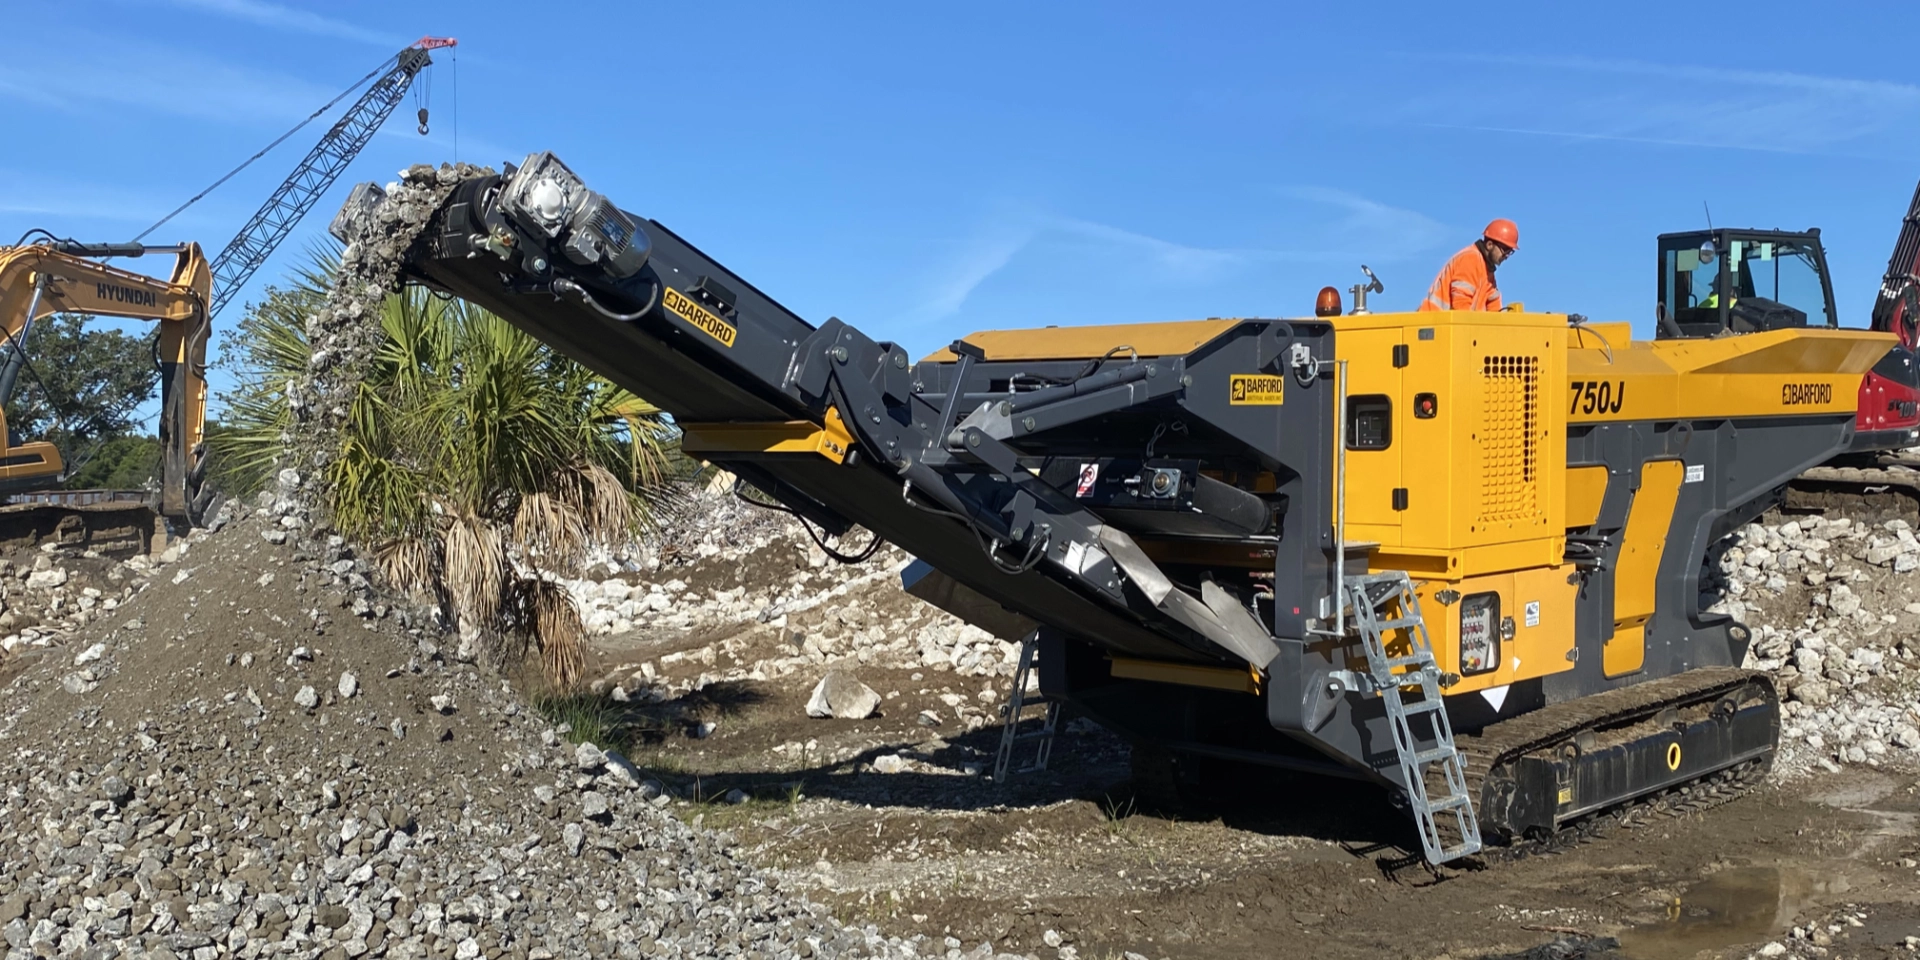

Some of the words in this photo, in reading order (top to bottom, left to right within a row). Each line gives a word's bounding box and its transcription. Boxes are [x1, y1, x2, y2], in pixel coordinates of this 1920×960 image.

[97, 282, 156, 308] HYUNDAI
[676, 297, 732, 343] BARFORD
[1246, 378, 1282, 393] BARFORD
[1570, 381, 1625, 415] 750J
[1791, 383, 1832, 405] BARFORD
